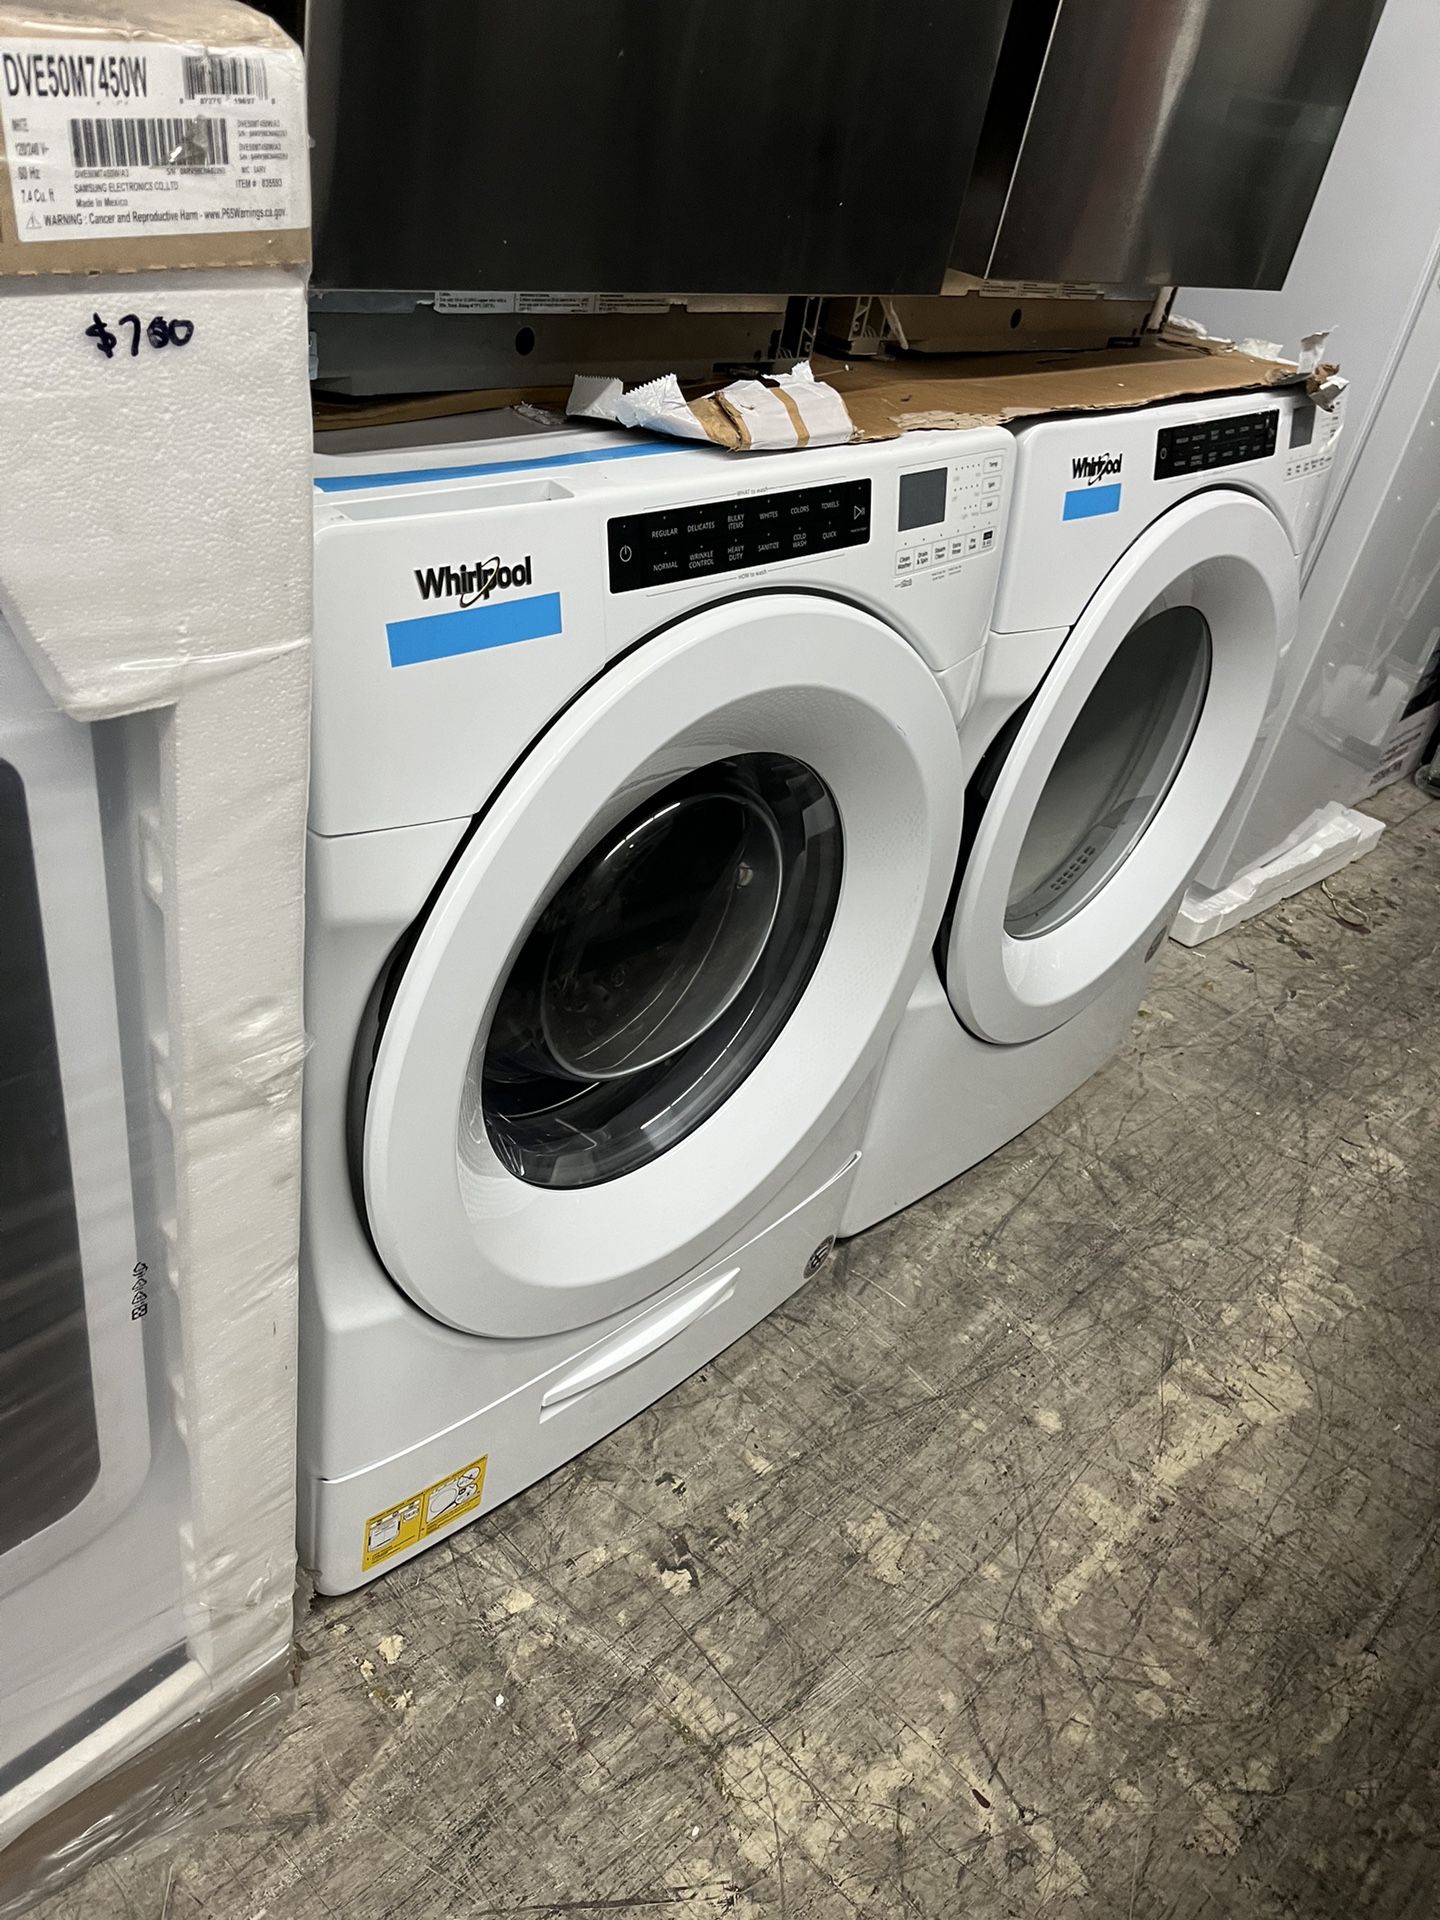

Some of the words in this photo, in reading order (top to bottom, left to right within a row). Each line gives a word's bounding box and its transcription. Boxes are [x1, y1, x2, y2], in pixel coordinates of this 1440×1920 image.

[3, 53, 147, 97] DVE50M7450W
[74, 182, 107, 194] SAMSUNG
[109, 181, 153, 193] ELECTRONICS
[76, 198, 94, 208] Made
[96, 198, 103, 207] in
[104, 197, 129, 207] Mexico
[89, 212, 115, 225] Cancer
[117, 211, 131, 224] and
[132, 209, 178, 225] Reproductive
[180, 208, 199, 221] Harm
[1072, 453, 1123, 486] Whirlpool
[821, 500, 840, 509] TOWELS
[759, 510, 779, 520] WHITES
[790, 505, 810, 515] COLORS
[727, 513, 745, 523] BULKY
[687, 521, 716, 533] DELICATES
[728, 521, 744, 530] ITEMS
[651, 527, 679, 538] REGULAR
[793, 532, 807, 541] COLD
[822, 530, 838, 540] QUICK
[758, 541, 780, 552] SANITIZE
[792, 540, 808, 548] WASH
[727, 545, 745, 554] HEAVY
[689, 550, 714, 561] WRINKLE
[728, 552, 744, 561] DUTY
[652, 561, 679, 571] NORMAL
[688, 558, 715, 569] CONTROL
[414, 555, 532, 608] Whirlpool
